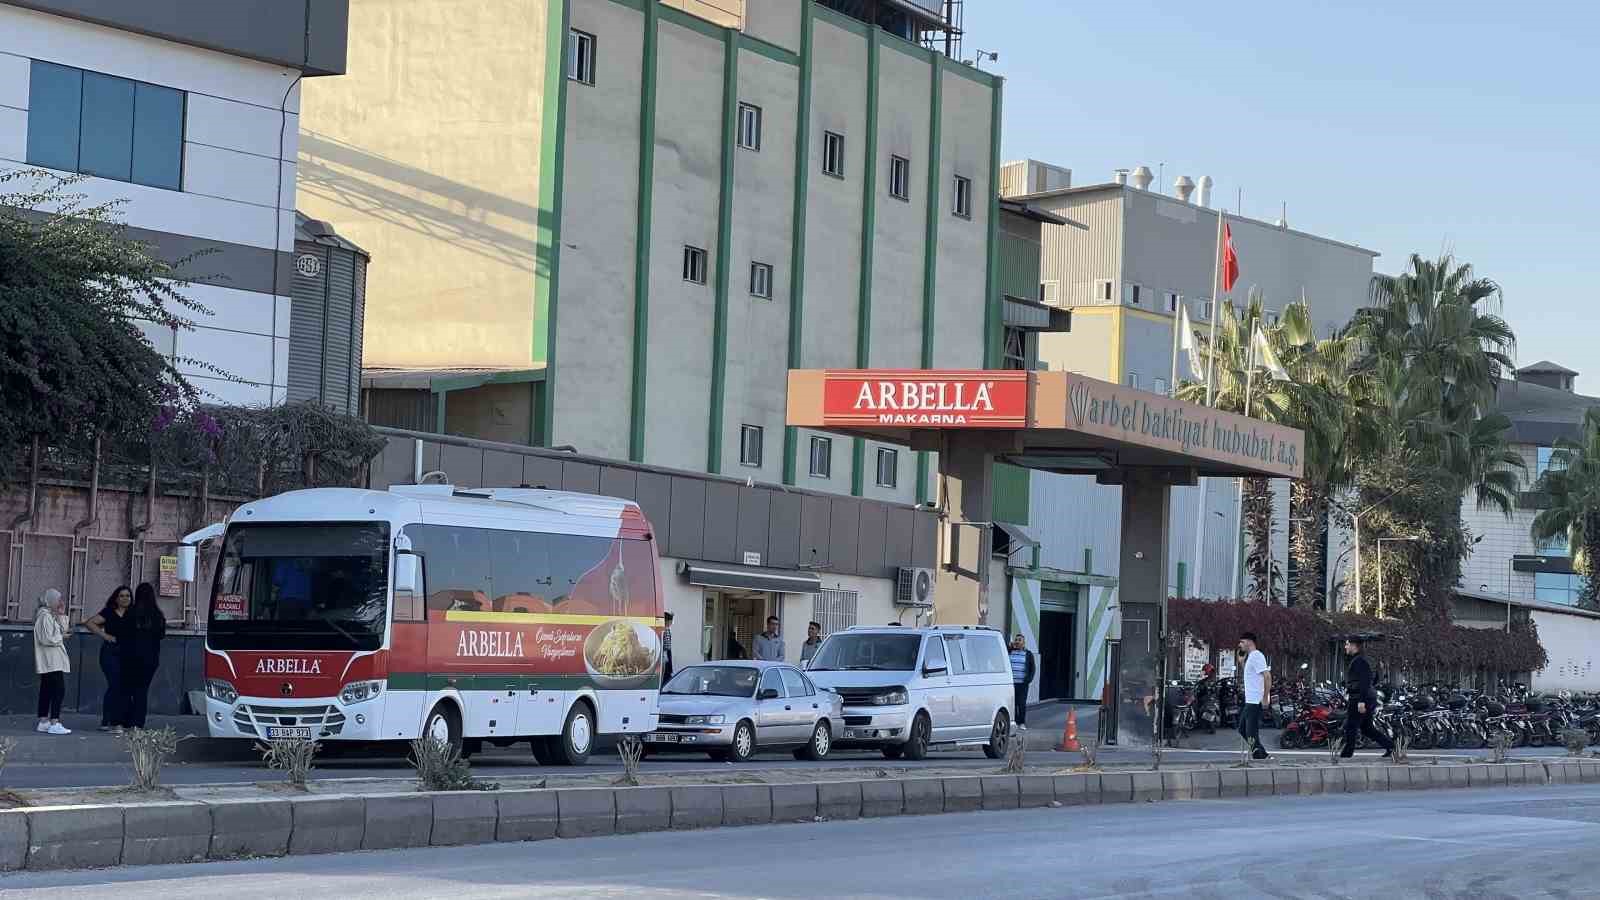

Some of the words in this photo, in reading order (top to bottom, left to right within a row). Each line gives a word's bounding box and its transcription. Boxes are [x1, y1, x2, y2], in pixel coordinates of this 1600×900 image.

[854, 381, 994, 411] ARBELLA
[879, 414, 966, 424] MAKARNA
[1088, 395, 1137, 432] arbel
[1142, 403, 1208, 447] bakliyat
[1213, 420, 1275, 462] hububat
[456, 630, 524, 657] ARBELLA
[256, 658, 321, 674] ARBELLA
